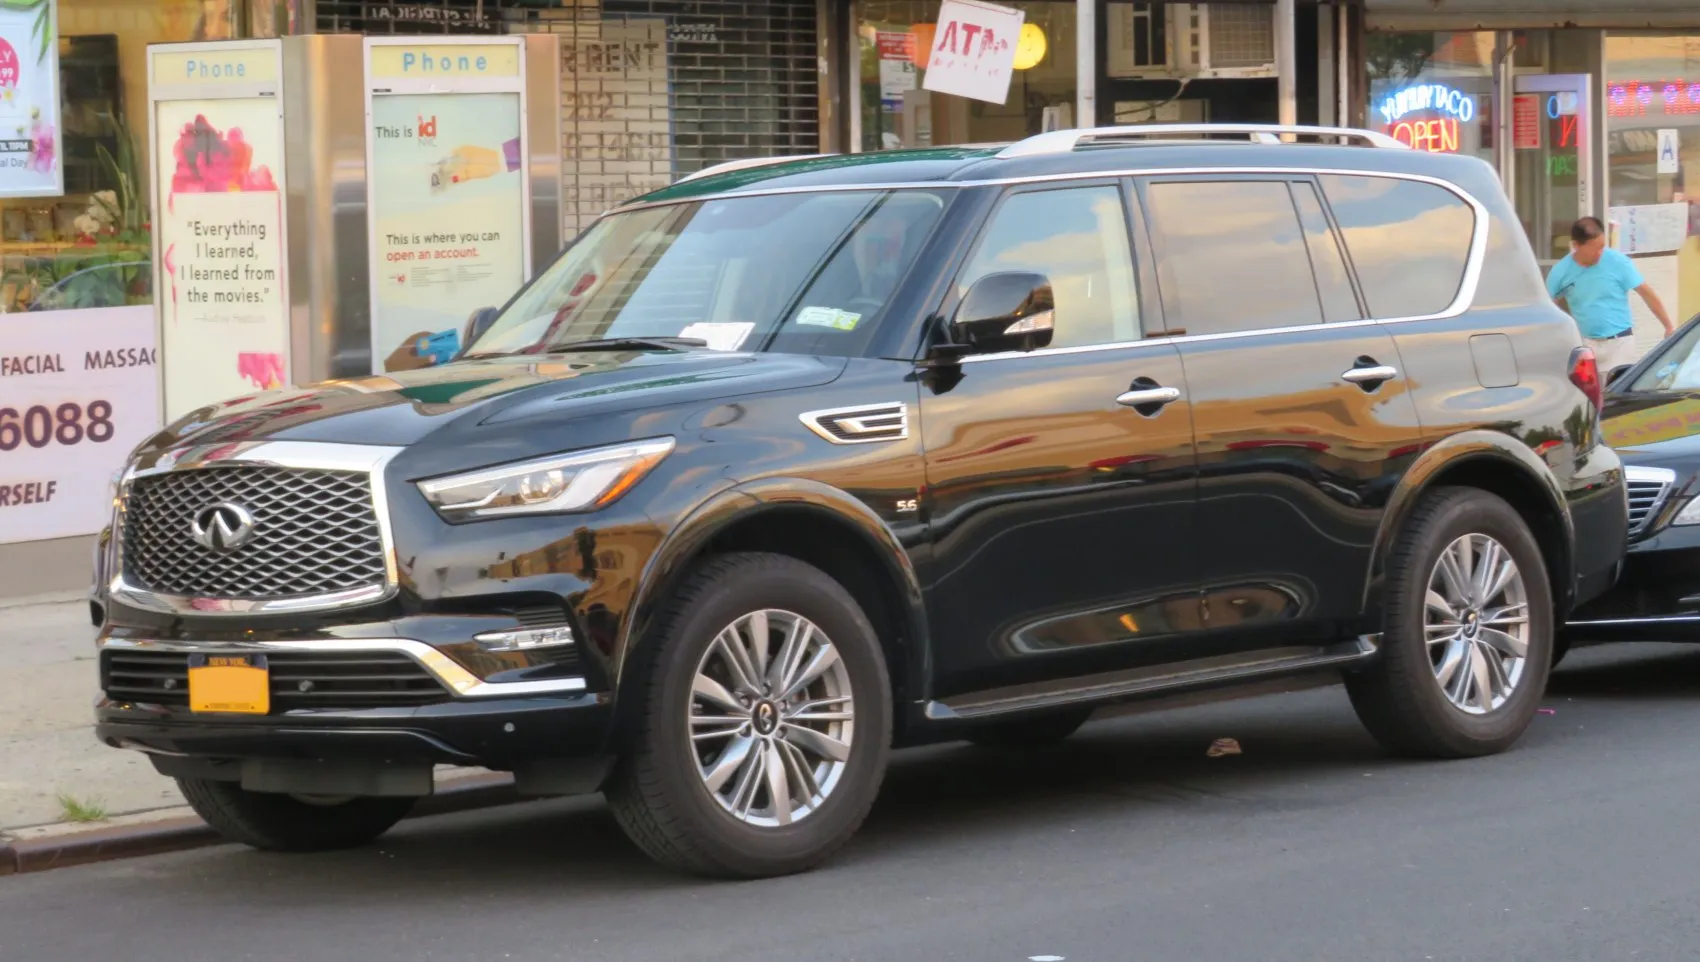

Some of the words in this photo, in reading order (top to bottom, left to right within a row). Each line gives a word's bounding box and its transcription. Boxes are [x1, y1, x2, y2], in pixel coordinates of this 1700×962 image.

[403, 52, 487, 71] Phone
[585, 43, 660, 73] RENT
[186, 60, 246, 79] Phone
[375, 126, 400, 138] This
[403, 125, 413, 138] is
[1393, 117, 1459, 152] OPEN
[10, 158, 28, 170] Day
[187, 220, 267, 241] "Everything
[386, 234, 408, 245] This
[412, 233, 420, 244] is
[424, 233, 456, 243] where
[459, 232, 479, 245] you
[481, 231, 500, 241] can
[204, 241, 259, 260] learned,
[386, 250, 416, 262] open
[418, 250, 431, 260] an
[190, 263, 240, 281] learned
[244, 263, 276, 281] from
[187, 286, 209, 303] the
[1, 353, 65, 376] FACIAL
[0, 399, 115, 451] 6088
